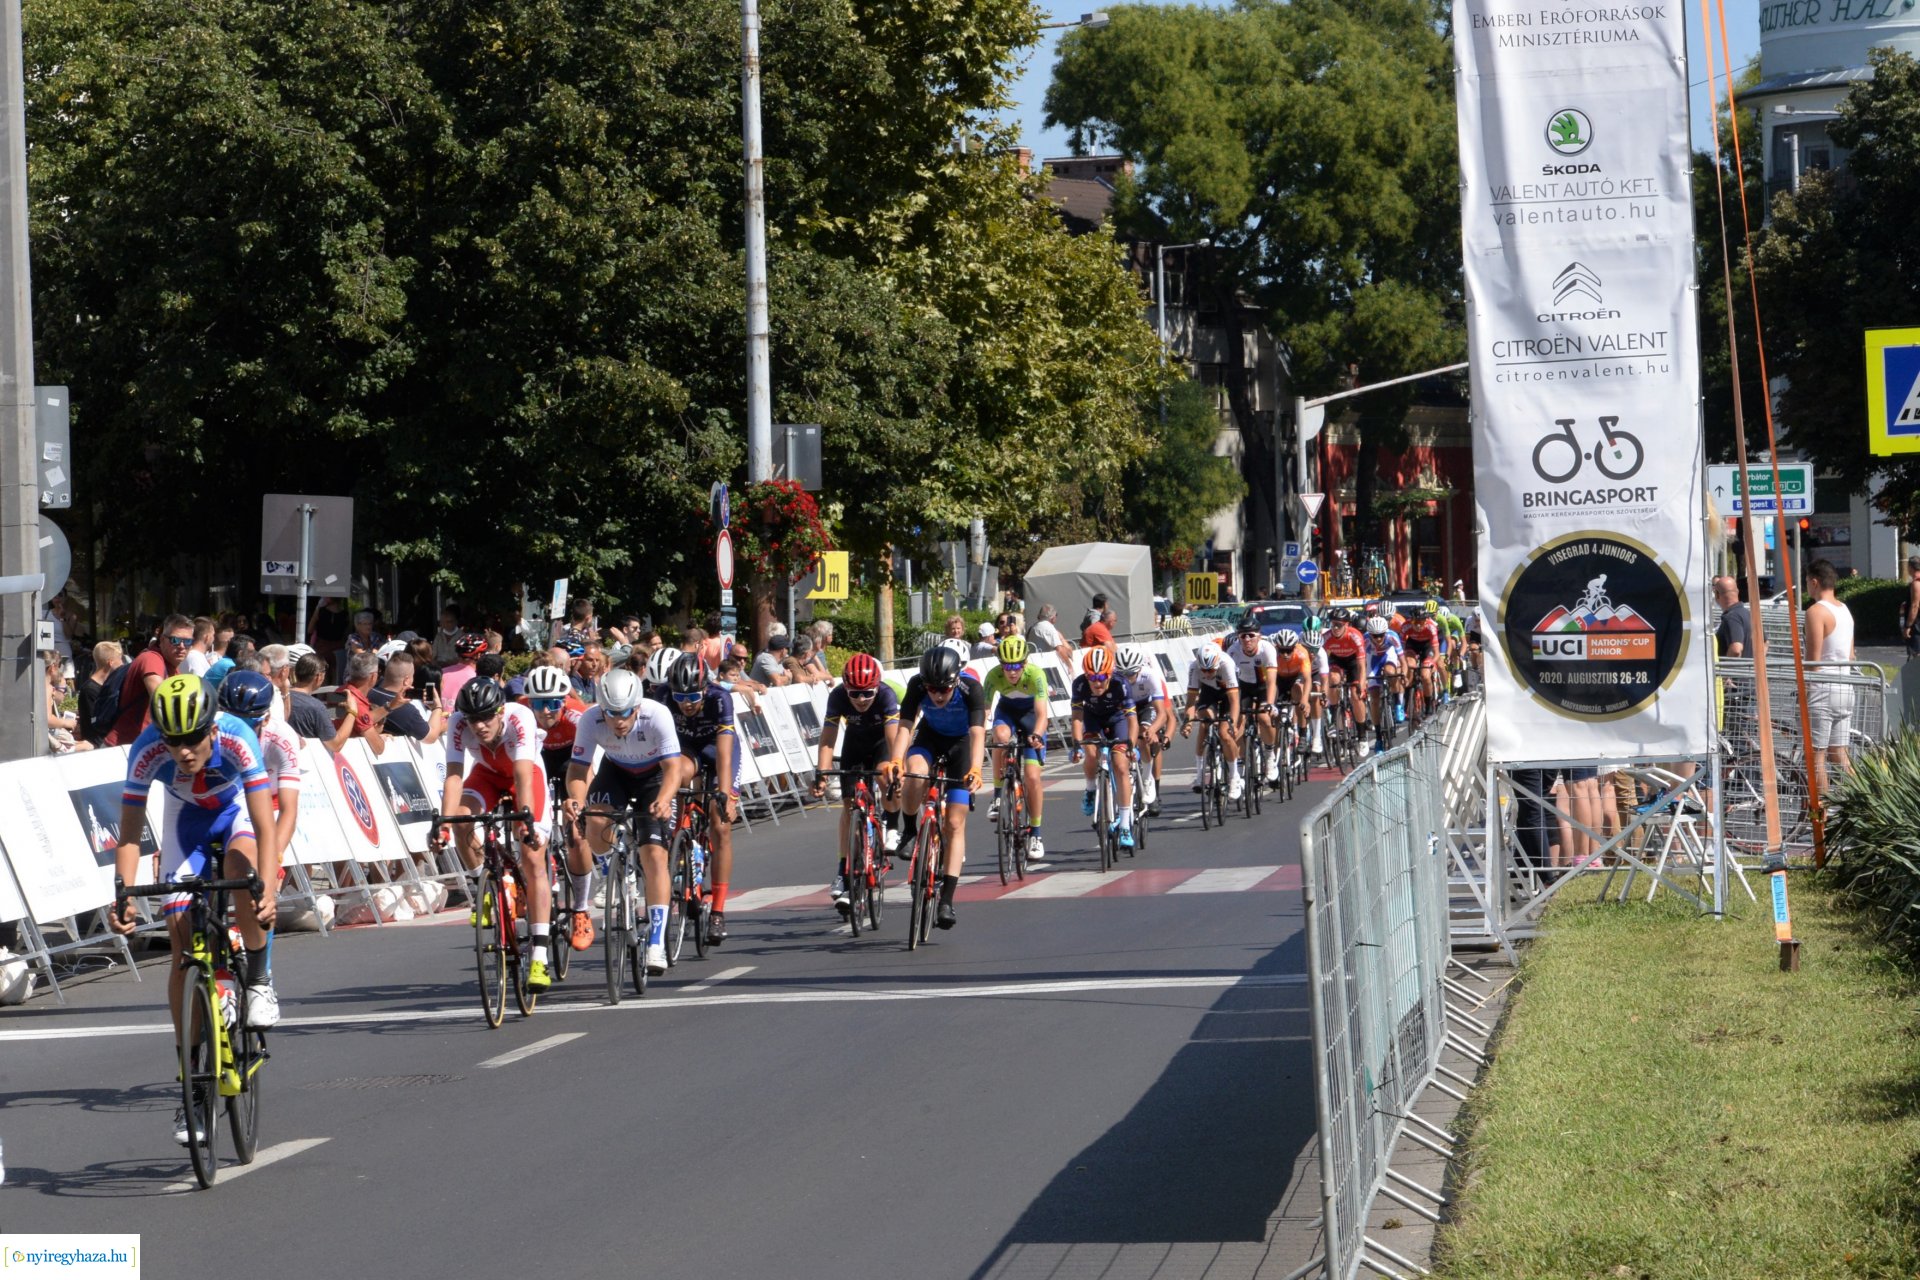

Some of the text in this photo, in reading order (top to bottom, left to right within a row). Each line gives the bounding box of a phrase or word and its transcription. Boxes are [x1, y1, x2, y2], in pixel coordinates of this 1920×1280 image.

[1473, 5, 1666, 29] EMBERI ERŐFORRÁSOK
[1499, 29, 1640, 48] MINISZTÉRIUMA
[1542, 164, 1601, 176] ŠKODA
[1490, 177, 1658, 201] VALENT AUTÓ KFT.
[1493, 203, 1656, 226] valentauto.hu
[1492, 331, 1668, 359] CITROËN VALENT
[1496, 360, 1669, 383] citroenvalent.hu
[1522, 487, 1658, 507] BRINGASPORT
[1547, 543, 1637, 566] VISEGRAD 4 JUNIORS
[1542, 640, 1583, 656] UCI
[1591, 647, 1622, 656] JUNIOR
[1632, 638, 1650, 647] CUP
[1539, 671, 1651, 685] 2020. AUGUSZTUS 26-28.
[263, 729, 298, 769] POLSKA
